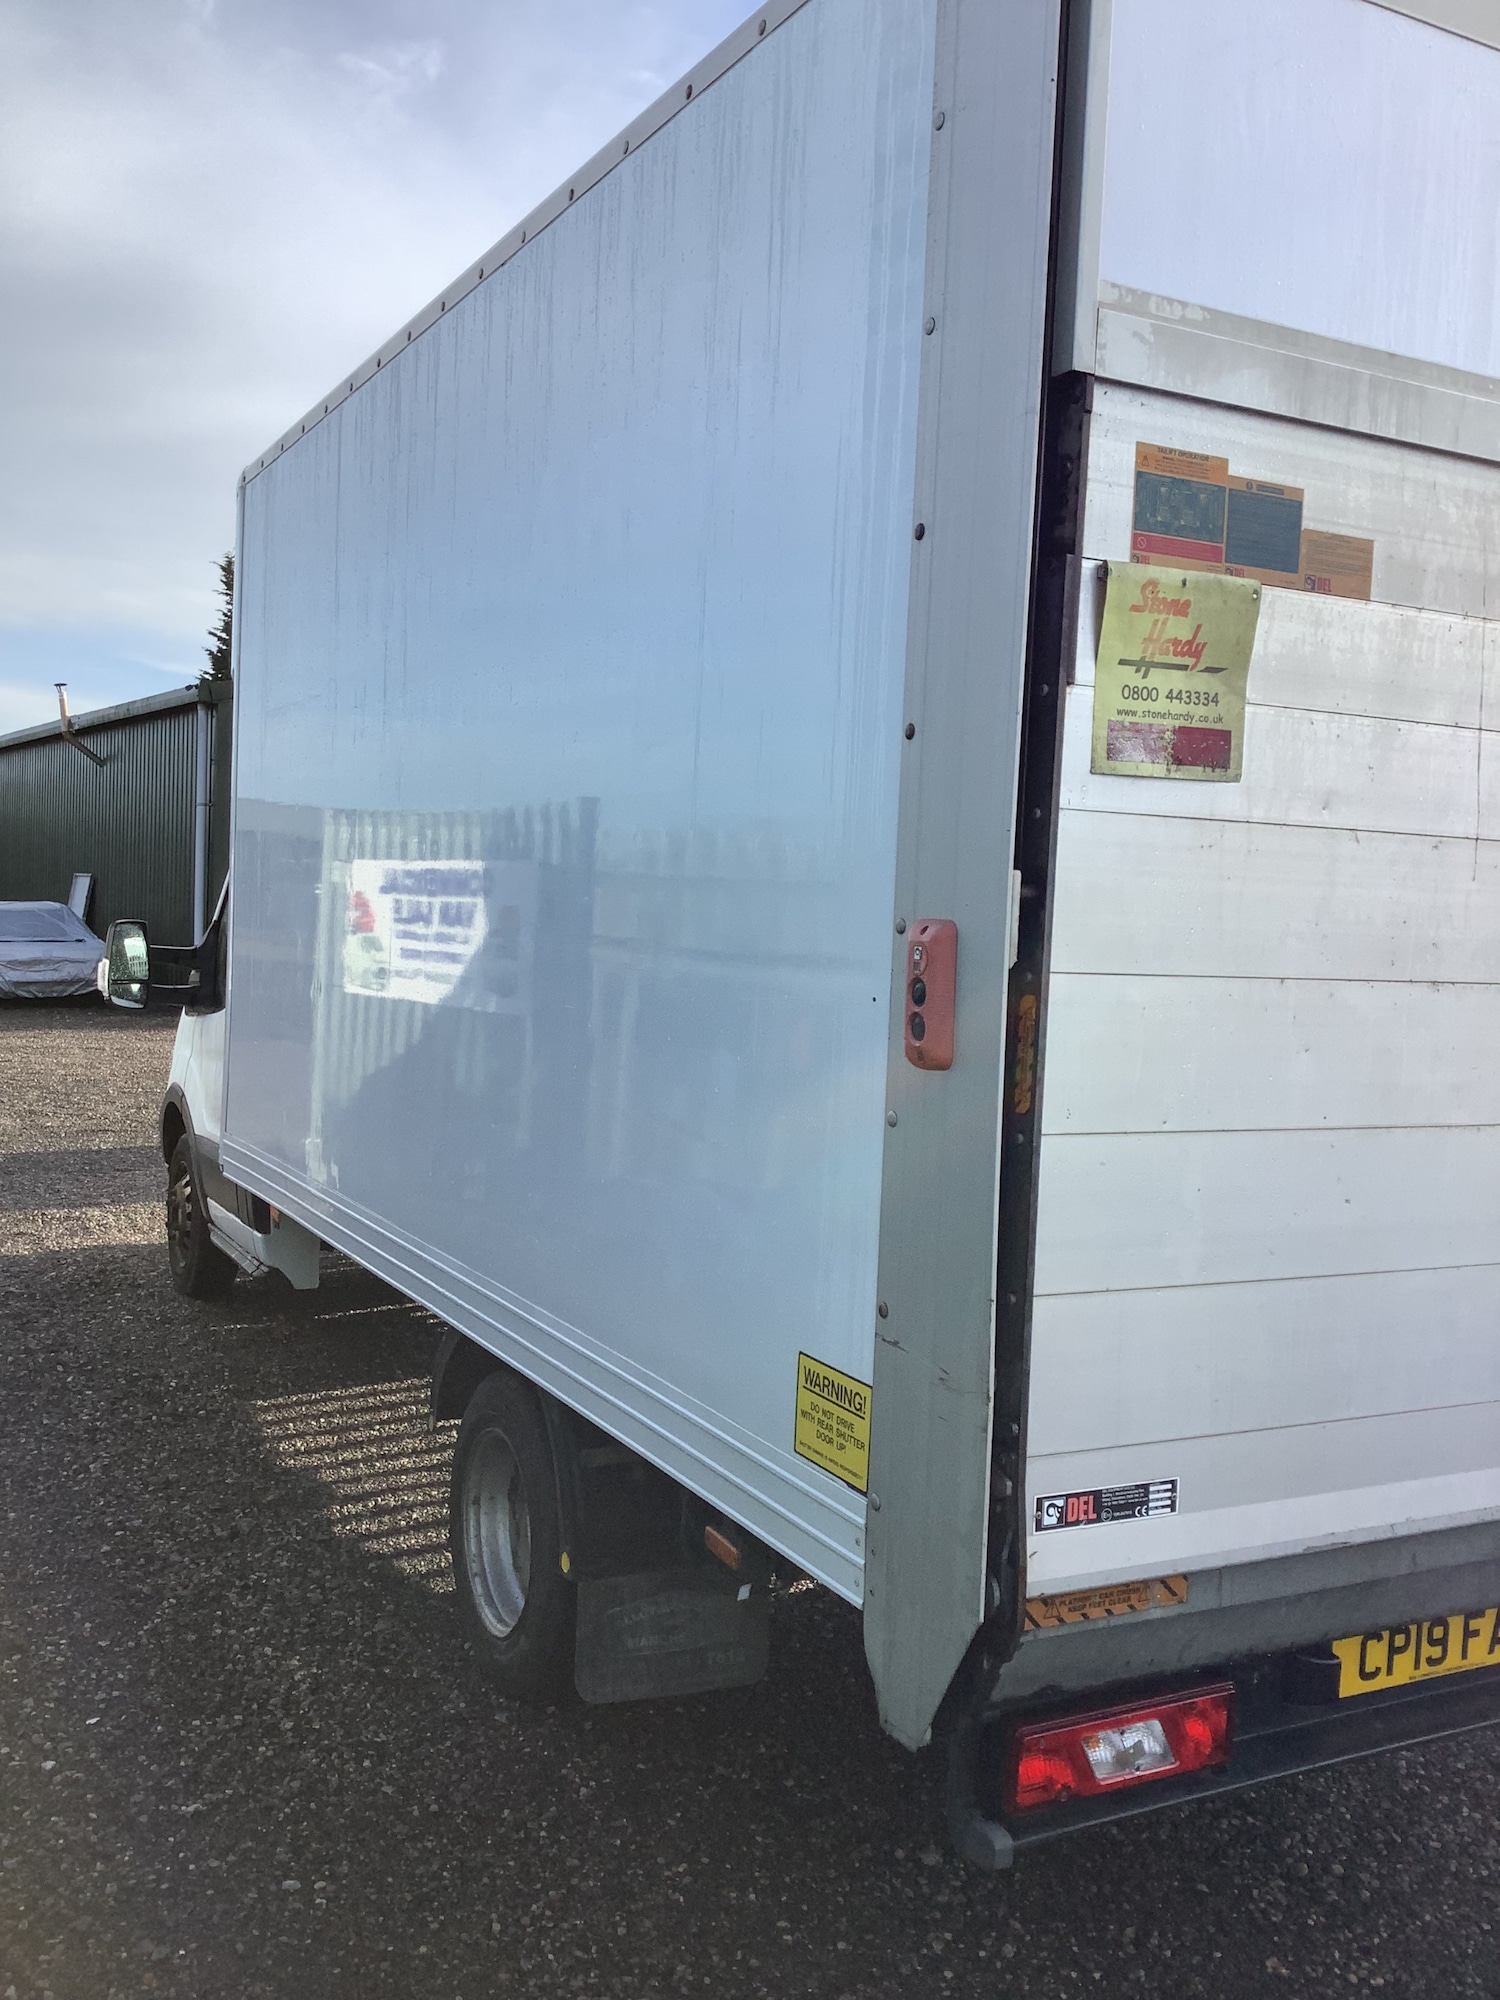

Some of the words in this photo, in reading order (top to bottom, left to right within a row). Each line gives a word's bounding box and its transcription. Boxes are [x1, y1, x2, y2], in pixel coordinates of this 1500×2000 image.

[1129, 578, 1192, 618] Stone
[1316, 577, 1332, 593] DEL
[1141, 618, 1208, 671] Hardy
[1121, 684, 1159, 702] 0800
[1165, 688, 1220, 707] 443334
[1116, 708, 1224, 724] www.stonehardy.co.uk
[803, 1365, 867, 1416] WARNING!
[800, 1409, 816, 1425] WITH
[816, 1417, 834, 1435] REAR
[836, 1428, 865, 1452] SHUTTER
[810, 1402, 820, 1414] DO
[821, 1408, 834, 1422] NOT
[836, 1415, 855, 1434] DRIVE
[816, 1429, 834, 1447] DOOR
[1066, 1495, 1097, 1522] DEL
[1359, 1617, 1449, 1681] CP19
